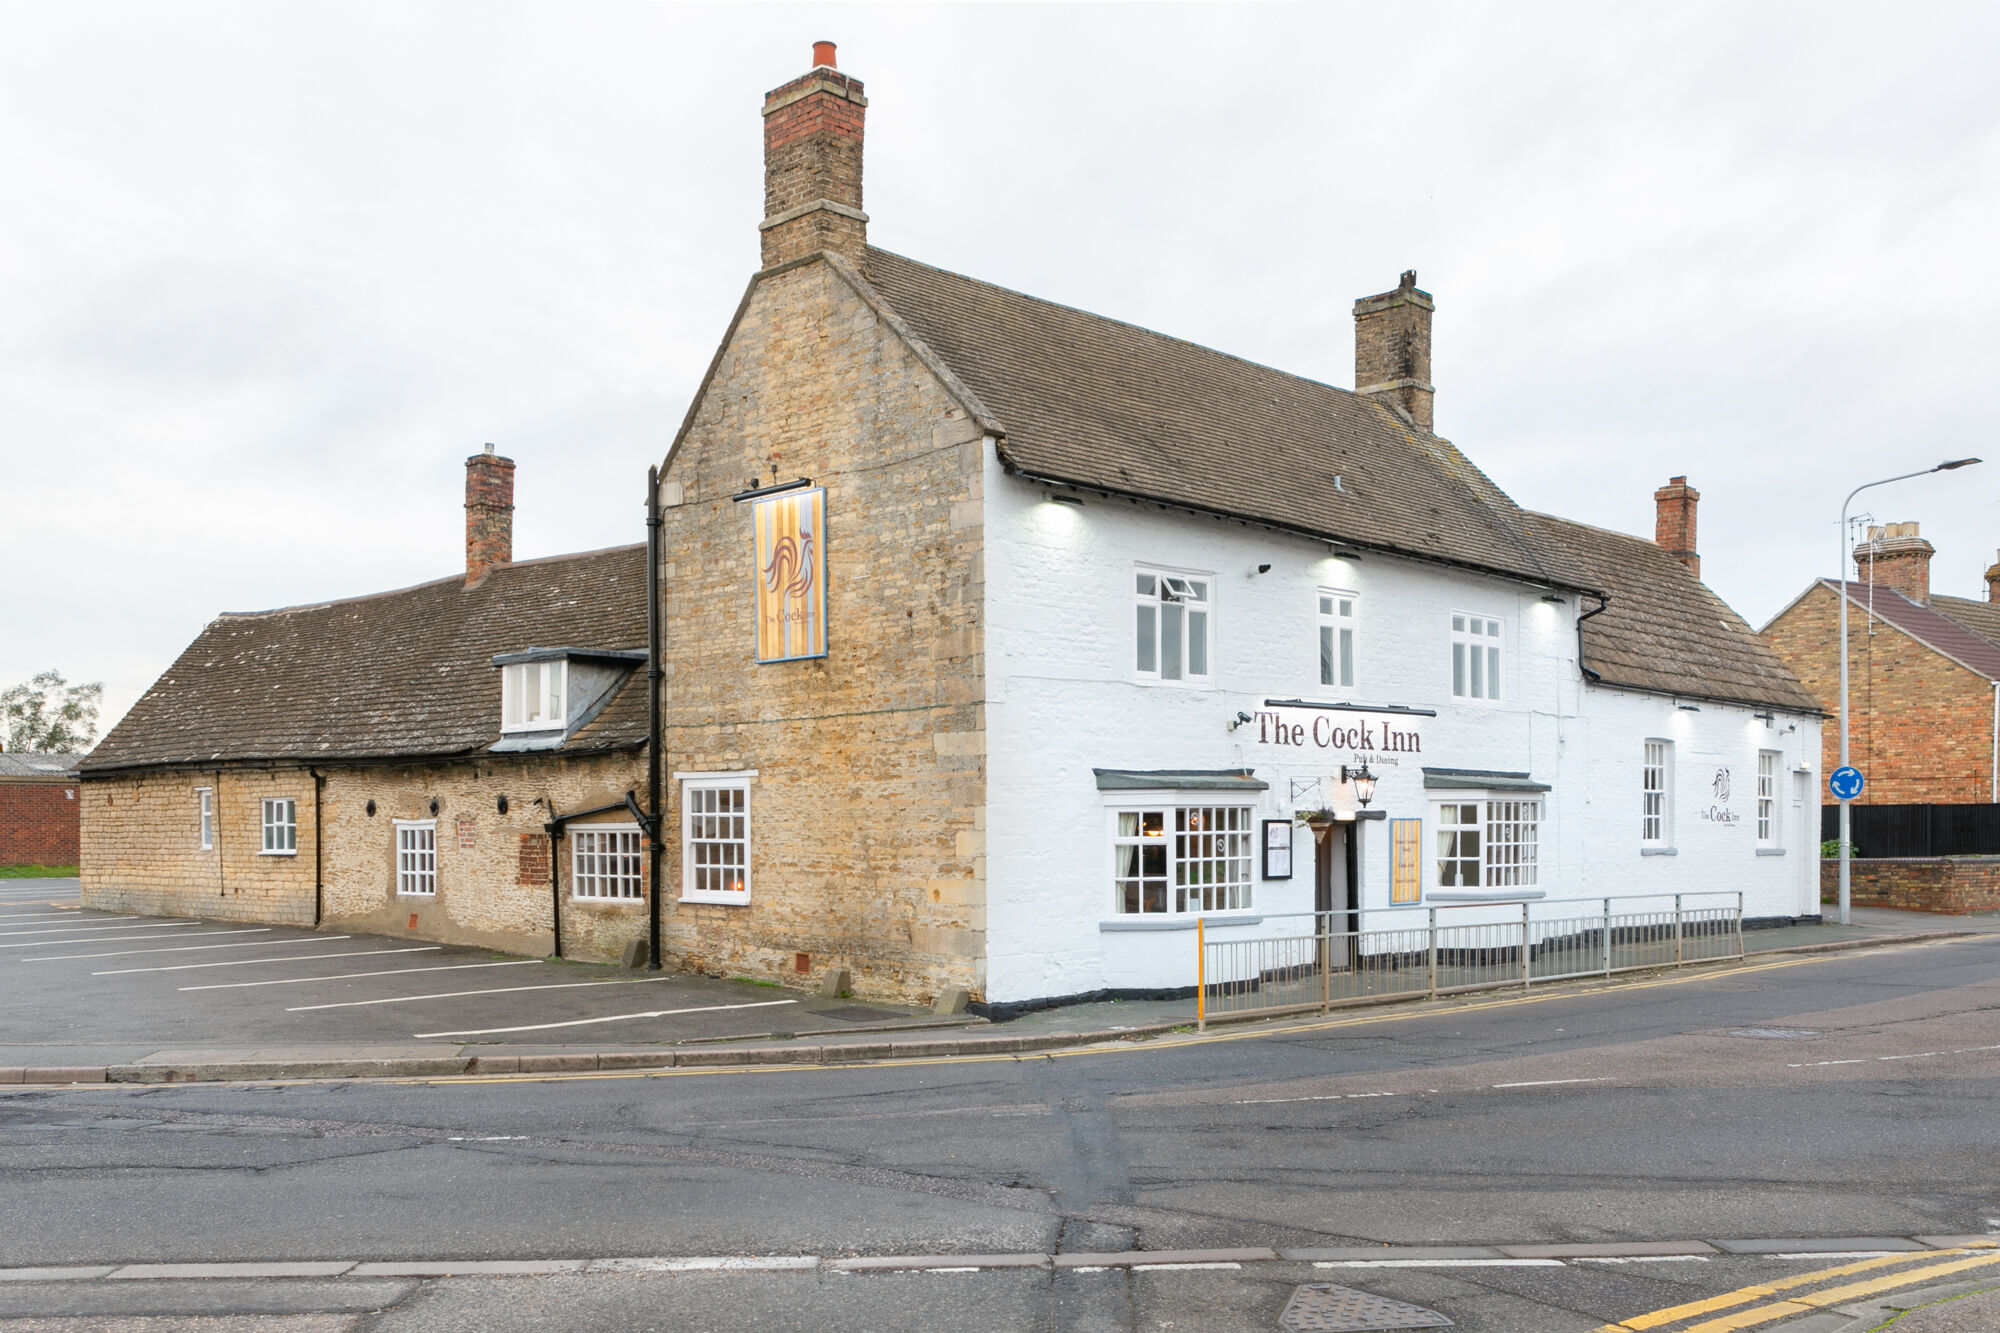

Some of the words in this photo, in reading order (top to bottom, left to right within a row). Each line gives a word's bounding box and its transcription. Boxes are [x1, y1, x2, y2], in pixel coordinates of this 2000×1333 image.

[777, 608, 803, 623] Cock
[1254, 711, 1304, 747] The
[1313, 715, 1375, 750] Cock
[1381, 721, 1422, 753] Inn
[1354, 753, 1367, 764] Pub
[1369, 754, 1374, 764] &
[1376, 755, 1399, 767] Dining
[1710, 805, 1731, 822] Cock
